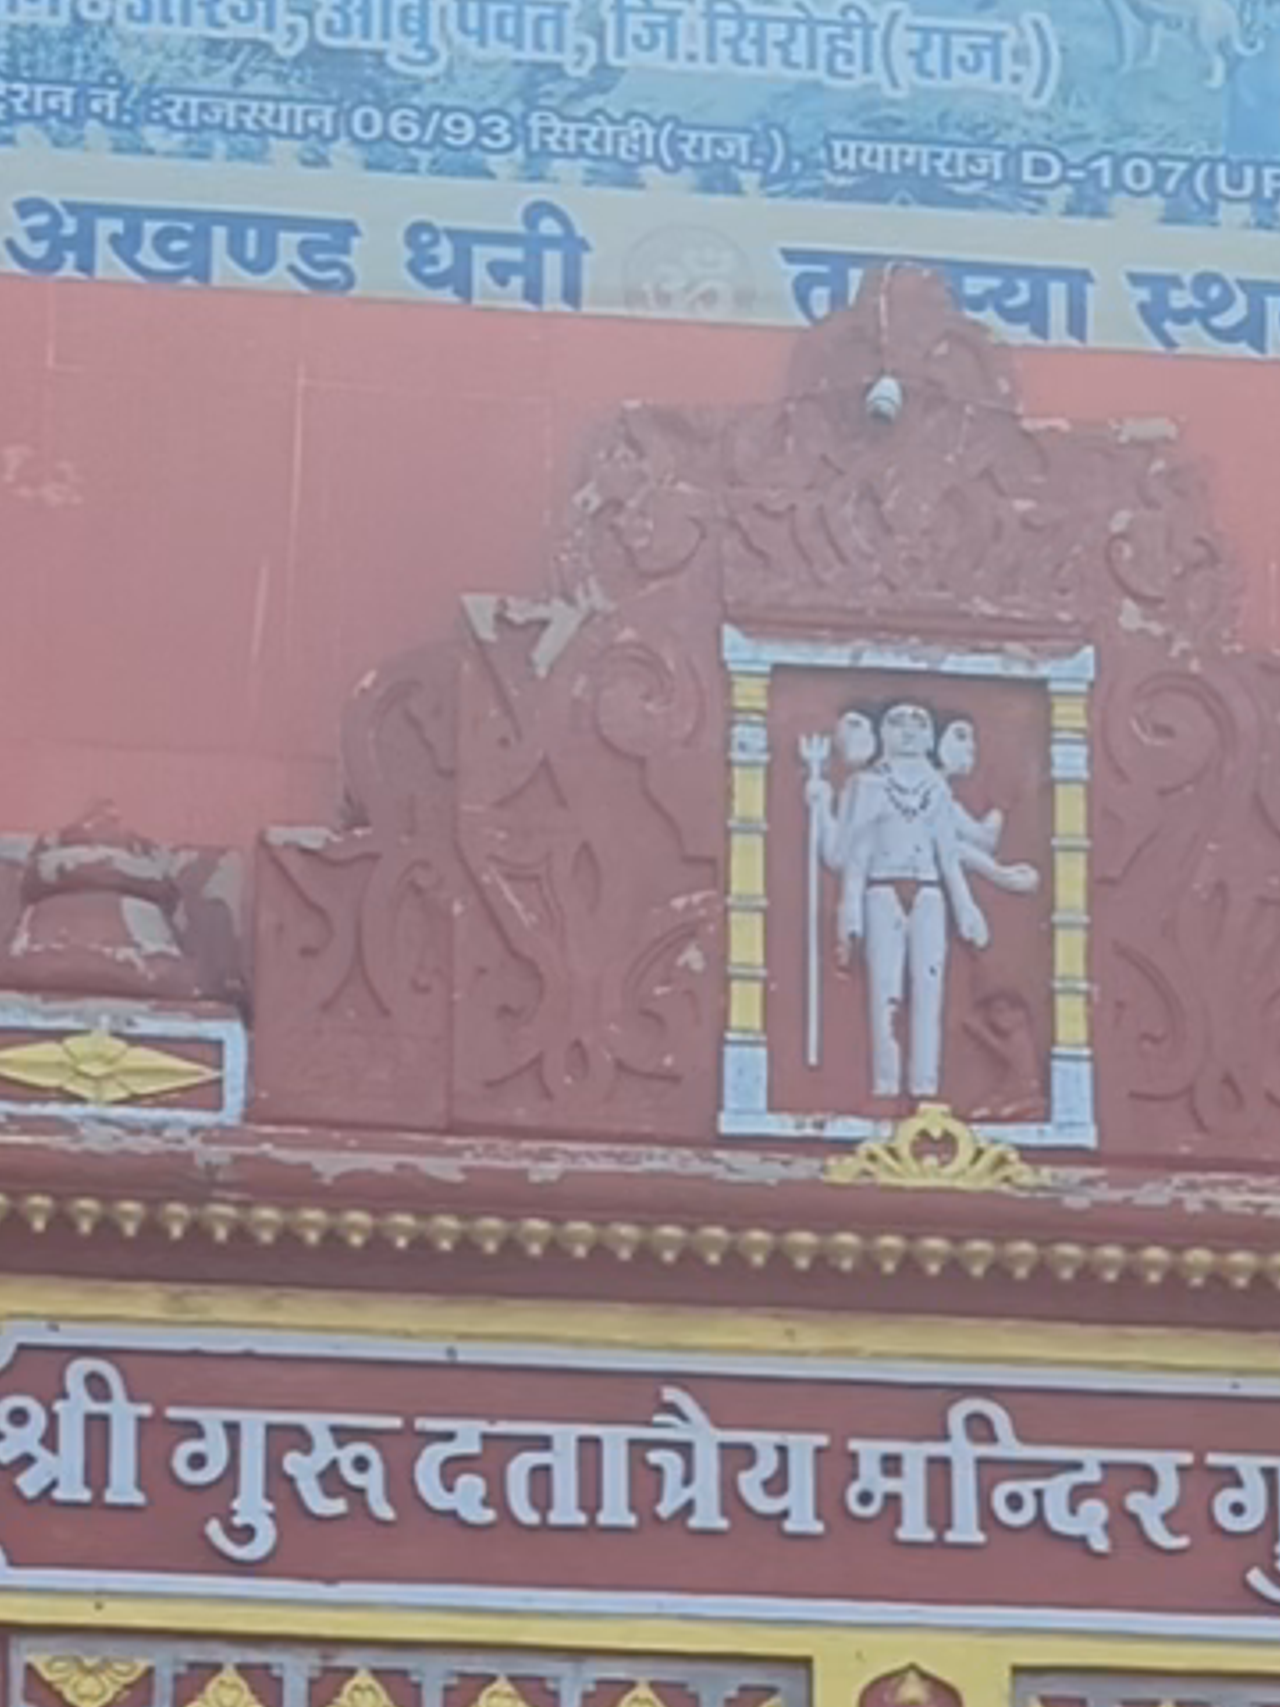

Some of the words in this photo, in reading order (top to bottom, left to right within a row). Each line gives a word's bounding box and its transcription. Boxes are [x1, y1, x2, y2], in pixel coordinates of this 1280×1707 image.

[350, 101, 513, 149] 06/93
[829, 137, 1005, 182] प्रयागराज
[6, 196, 361, 294] अखण्ड
[165, 1406, 403, 1561] गुरू
[845, 1396, 1194, 1554] मन्दिर
